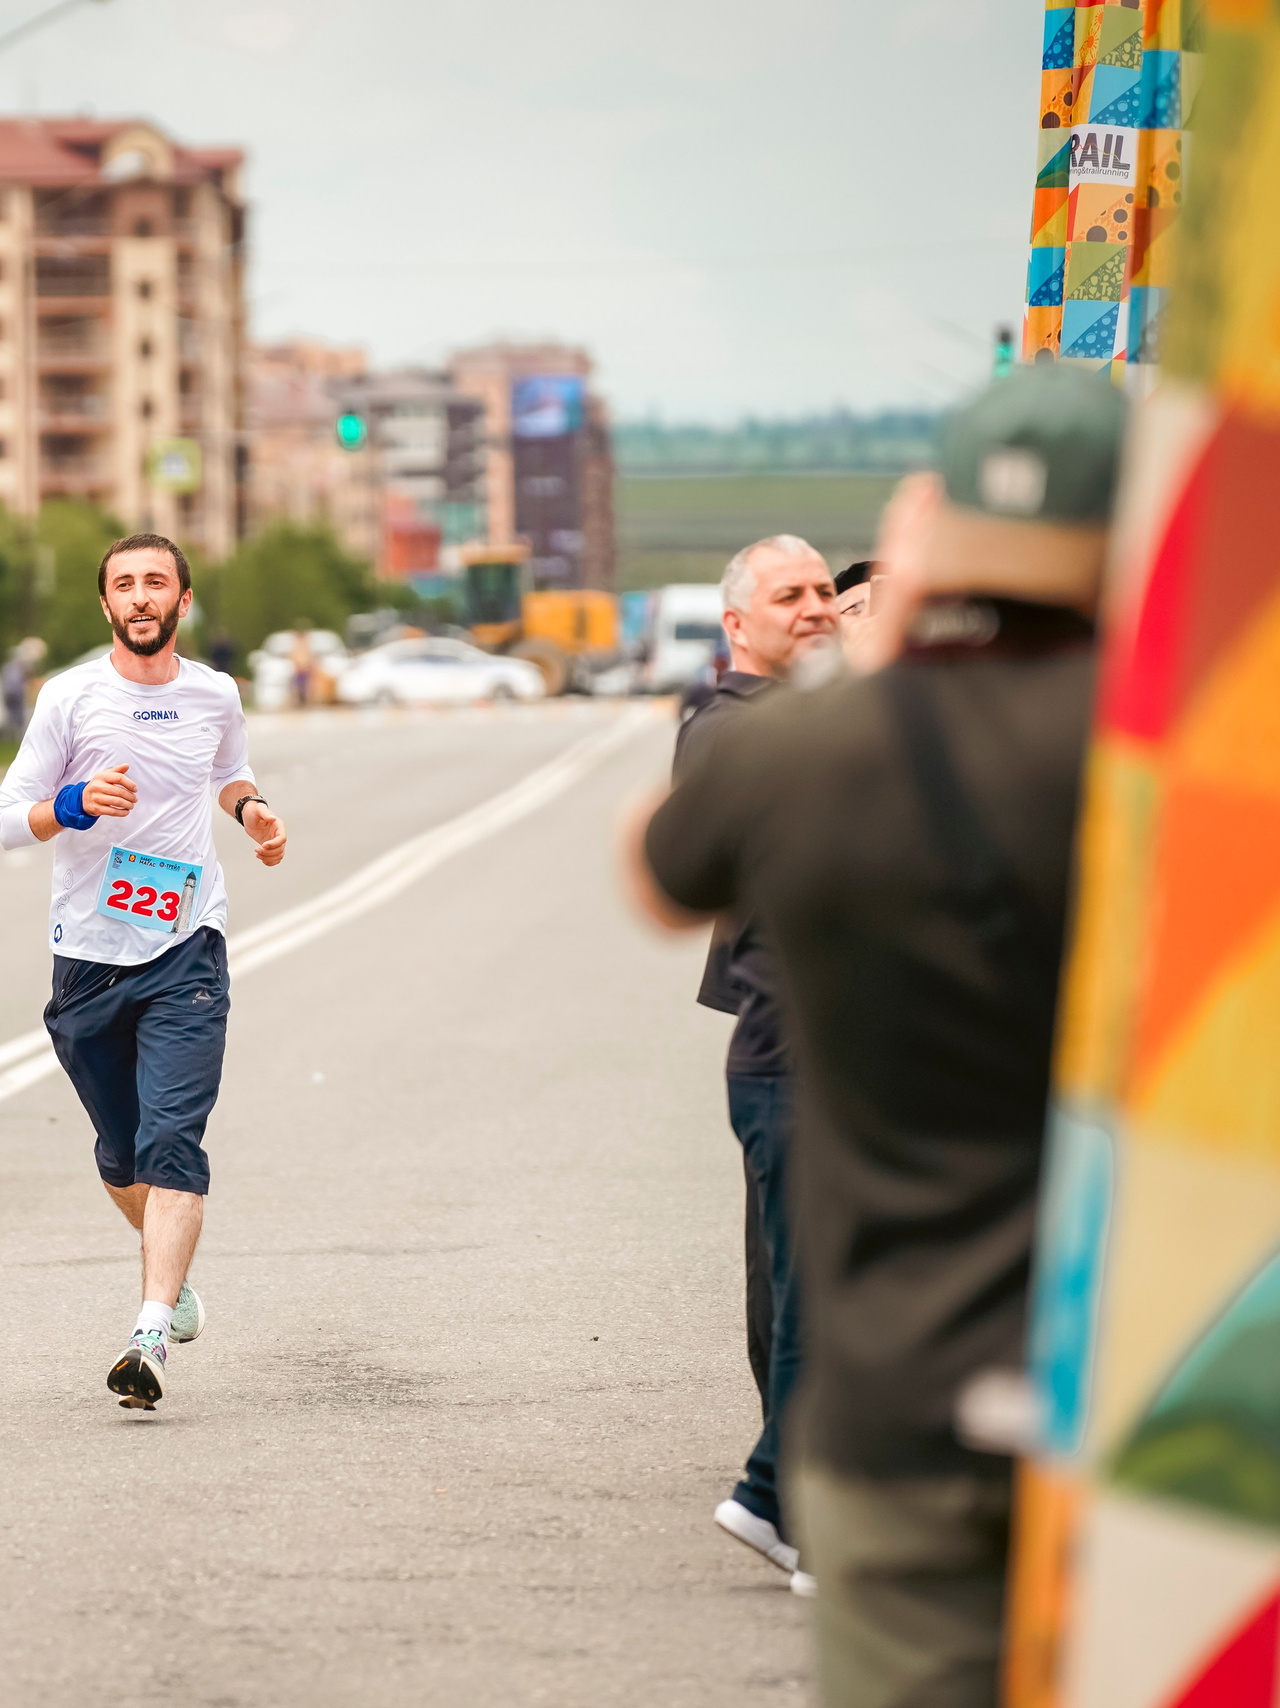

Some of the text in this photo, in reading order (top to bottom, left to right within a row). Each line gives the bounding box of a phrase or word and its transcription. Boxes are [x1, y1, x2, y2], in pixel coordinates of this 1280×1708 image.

[132, 710, 180, 721] GORNAYA
[139, 860, 156, 868] МАГАС
[106, 879, 181, 922] 223
